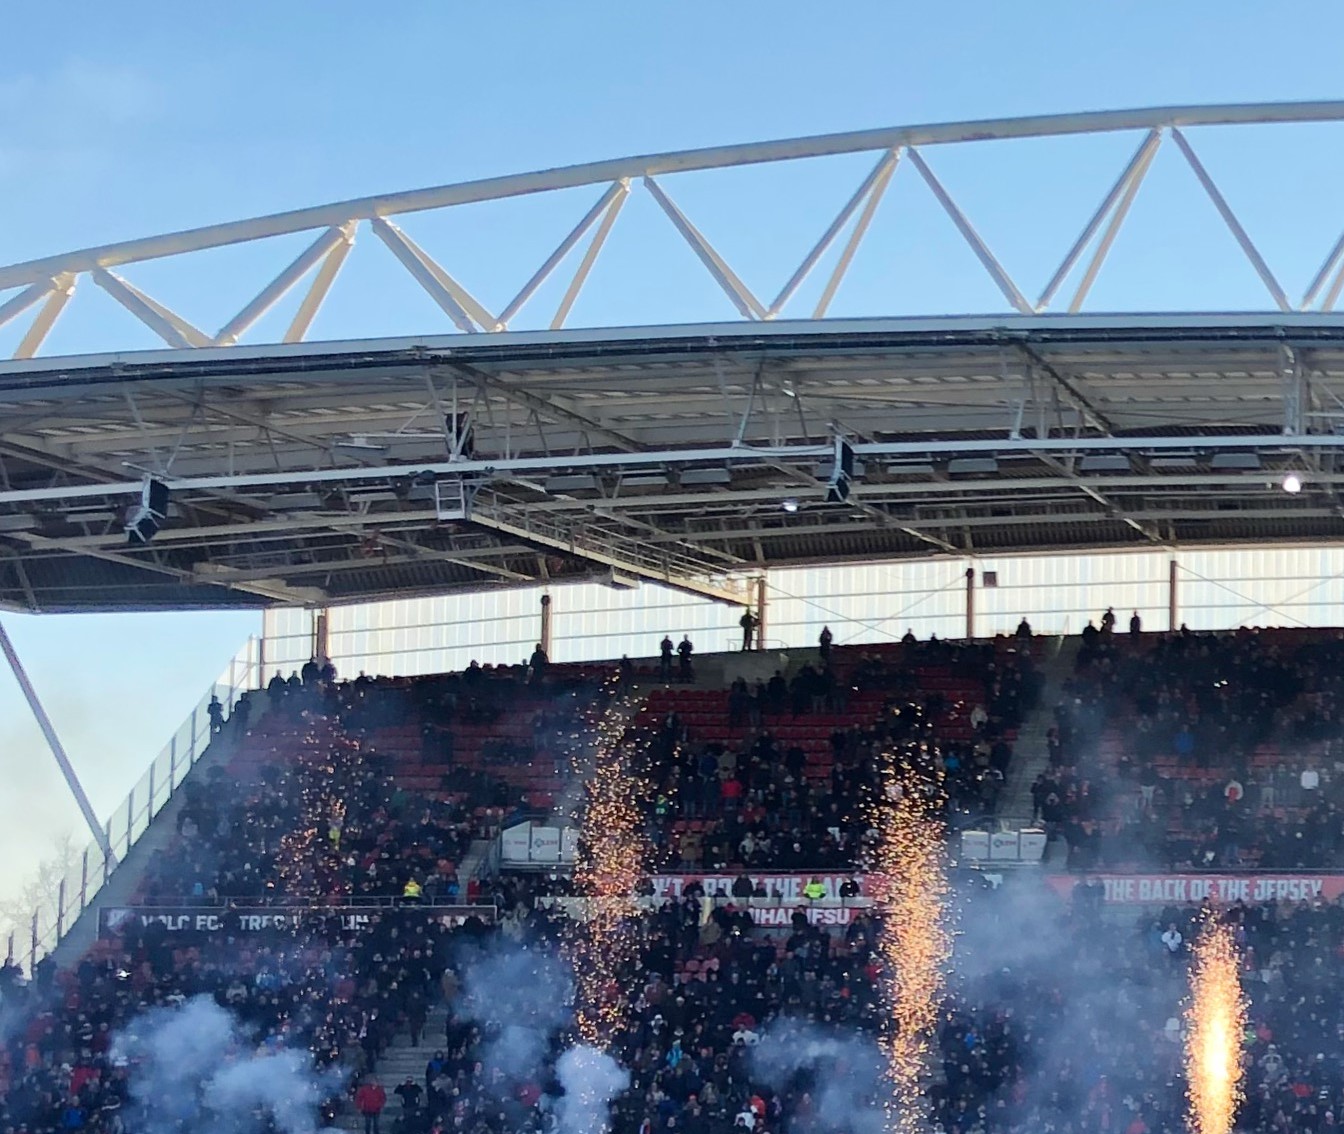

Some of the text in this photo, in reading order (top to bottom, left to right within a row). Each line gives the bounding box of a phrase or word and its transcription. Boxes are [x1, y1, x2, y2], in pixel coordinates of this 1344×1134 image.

[1103, 879, 1133, 900] THE
[1139, 879, 1187, 900] BACK
[1217, 879, 1250, 900] THE
[1253, 879, 1323, 900] JERSEY
